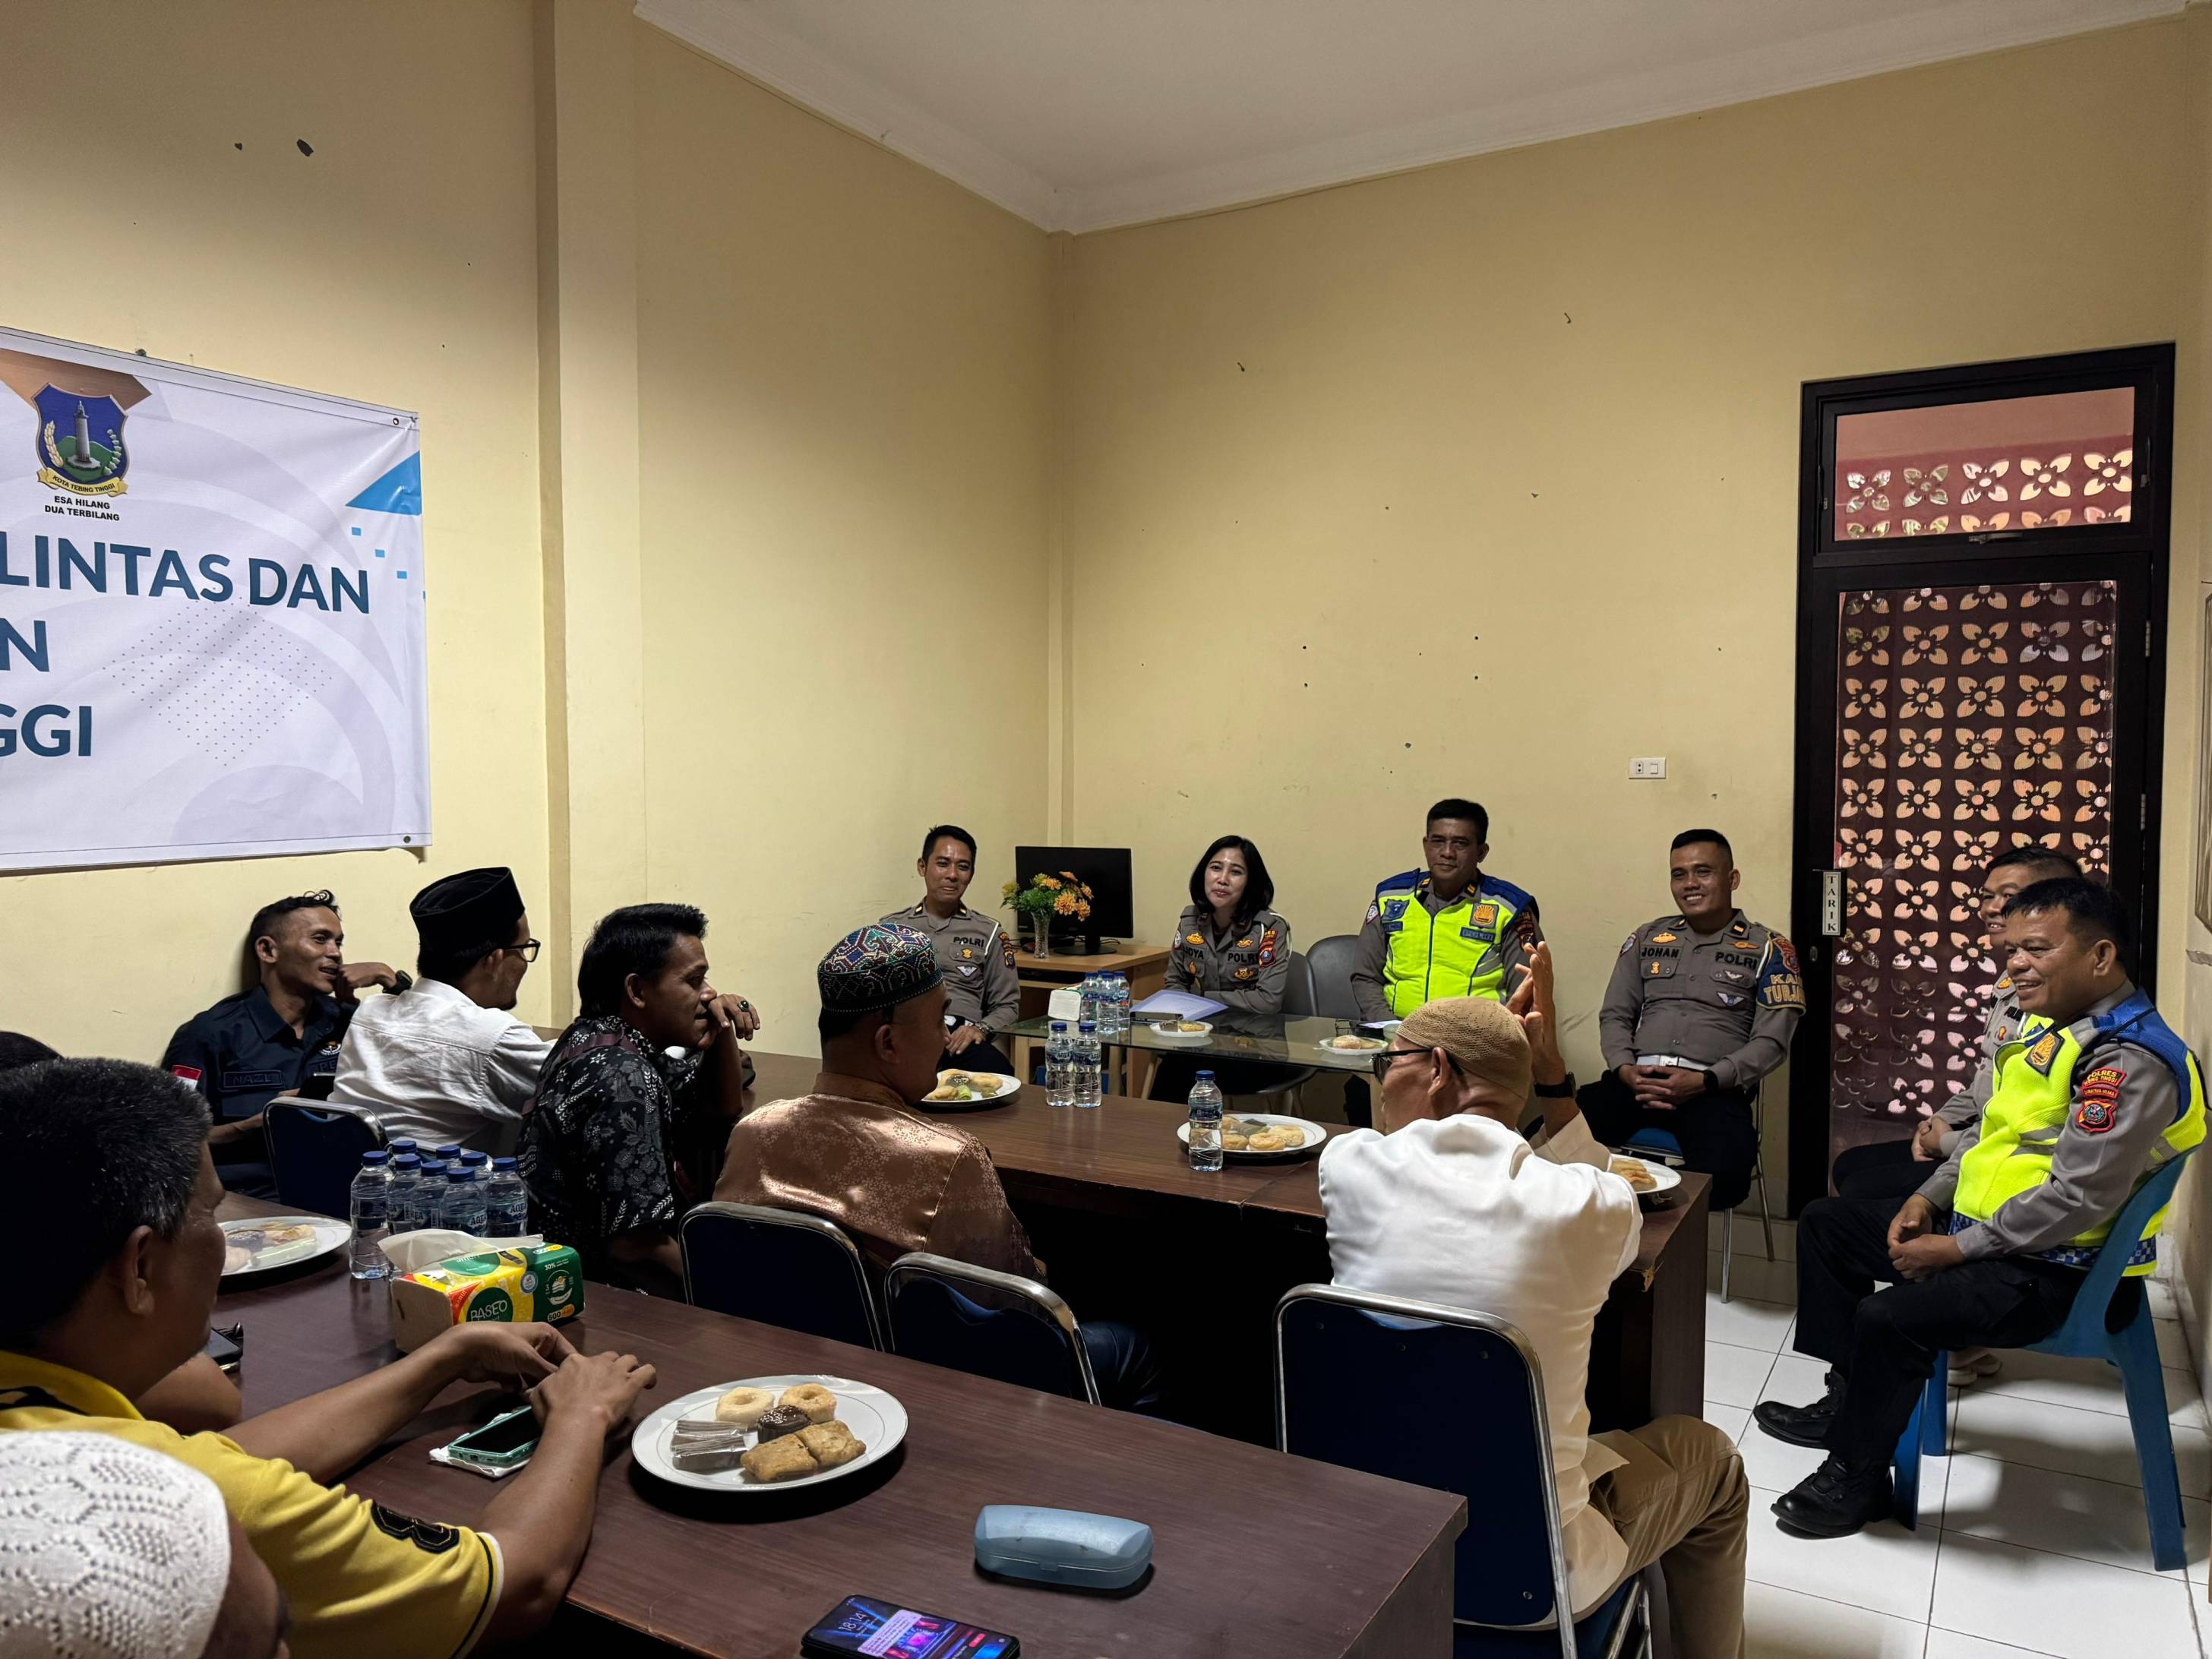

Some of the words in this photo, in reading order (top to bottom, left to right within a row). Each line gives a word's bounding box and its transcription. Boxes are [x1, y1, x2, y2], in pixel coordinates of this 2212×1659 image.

[52, 475, 69, 488] KOTA
[71, 484, 93, 493] TEBING
[94, 482, 115, 493] TINGGI
[54, 495, 73, 505] ESA
[75, 498, 110, 510] HILANG
[45, 504, 65, 515] DUA
[67, 507, 120, 521] TERBILANG
[0, 532, 234, 602] LINTAS
[248, 558, 370, 615] DAN
[1827, 875, 1836, 931] TARIK
[953, 937, 984, 948] POLRI
[1641, 946, 1680, 959] JOHAN
[1714, 951, 1759, 970] POLRI
[470, 1299, 508, 1322] PASEO
